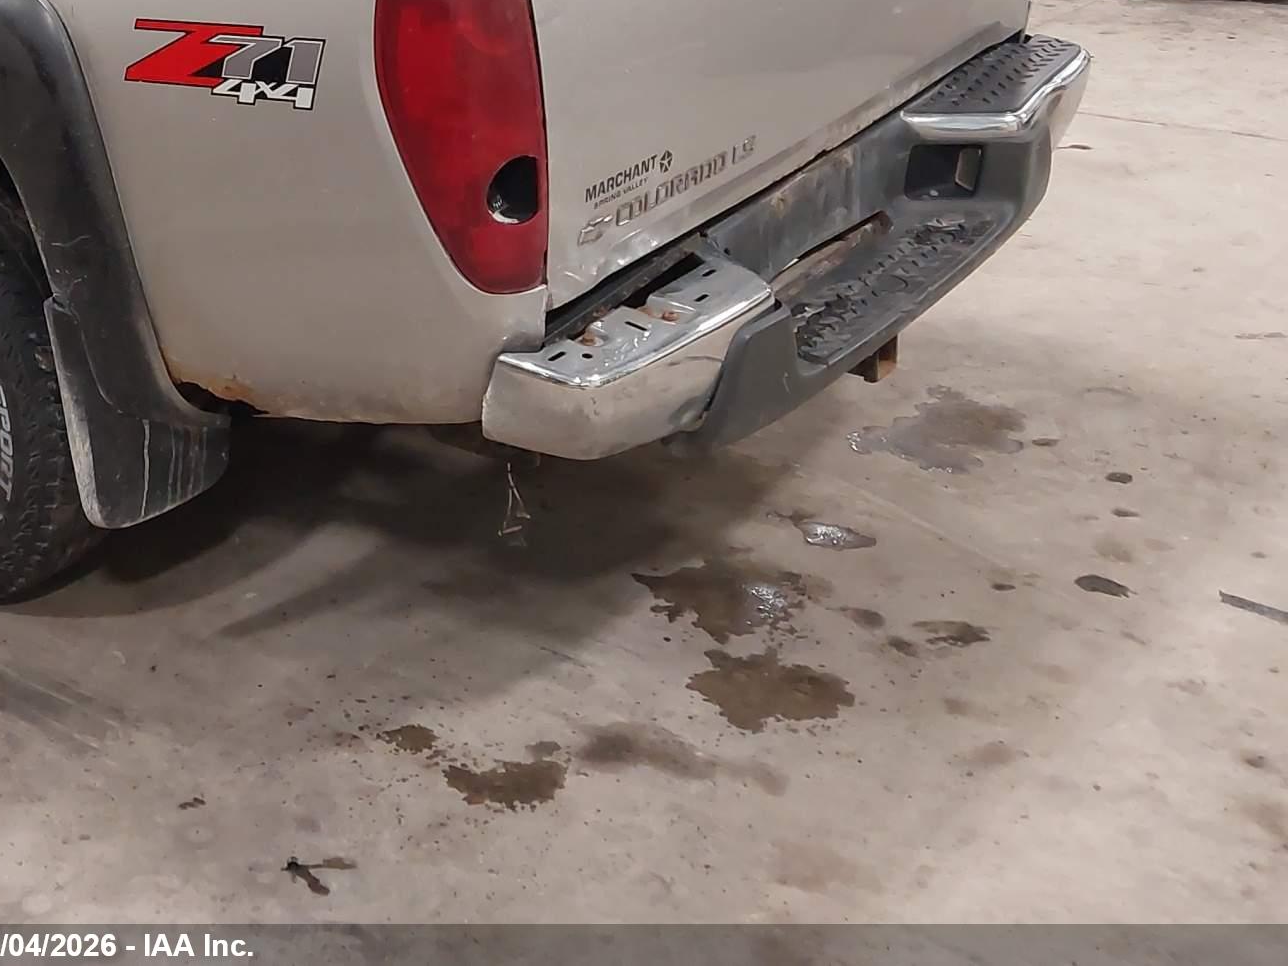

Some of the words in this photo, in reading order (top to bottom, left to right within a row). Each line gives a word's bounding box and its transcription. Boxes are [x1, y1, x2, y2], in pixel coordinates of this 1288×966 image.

[124, 18, 326, 88] Z71
[585, 154, 658, 203] MARCHANT
[616, 150, 728, 226] COLORADO
[623, 177, 648, 194] VALLEY
